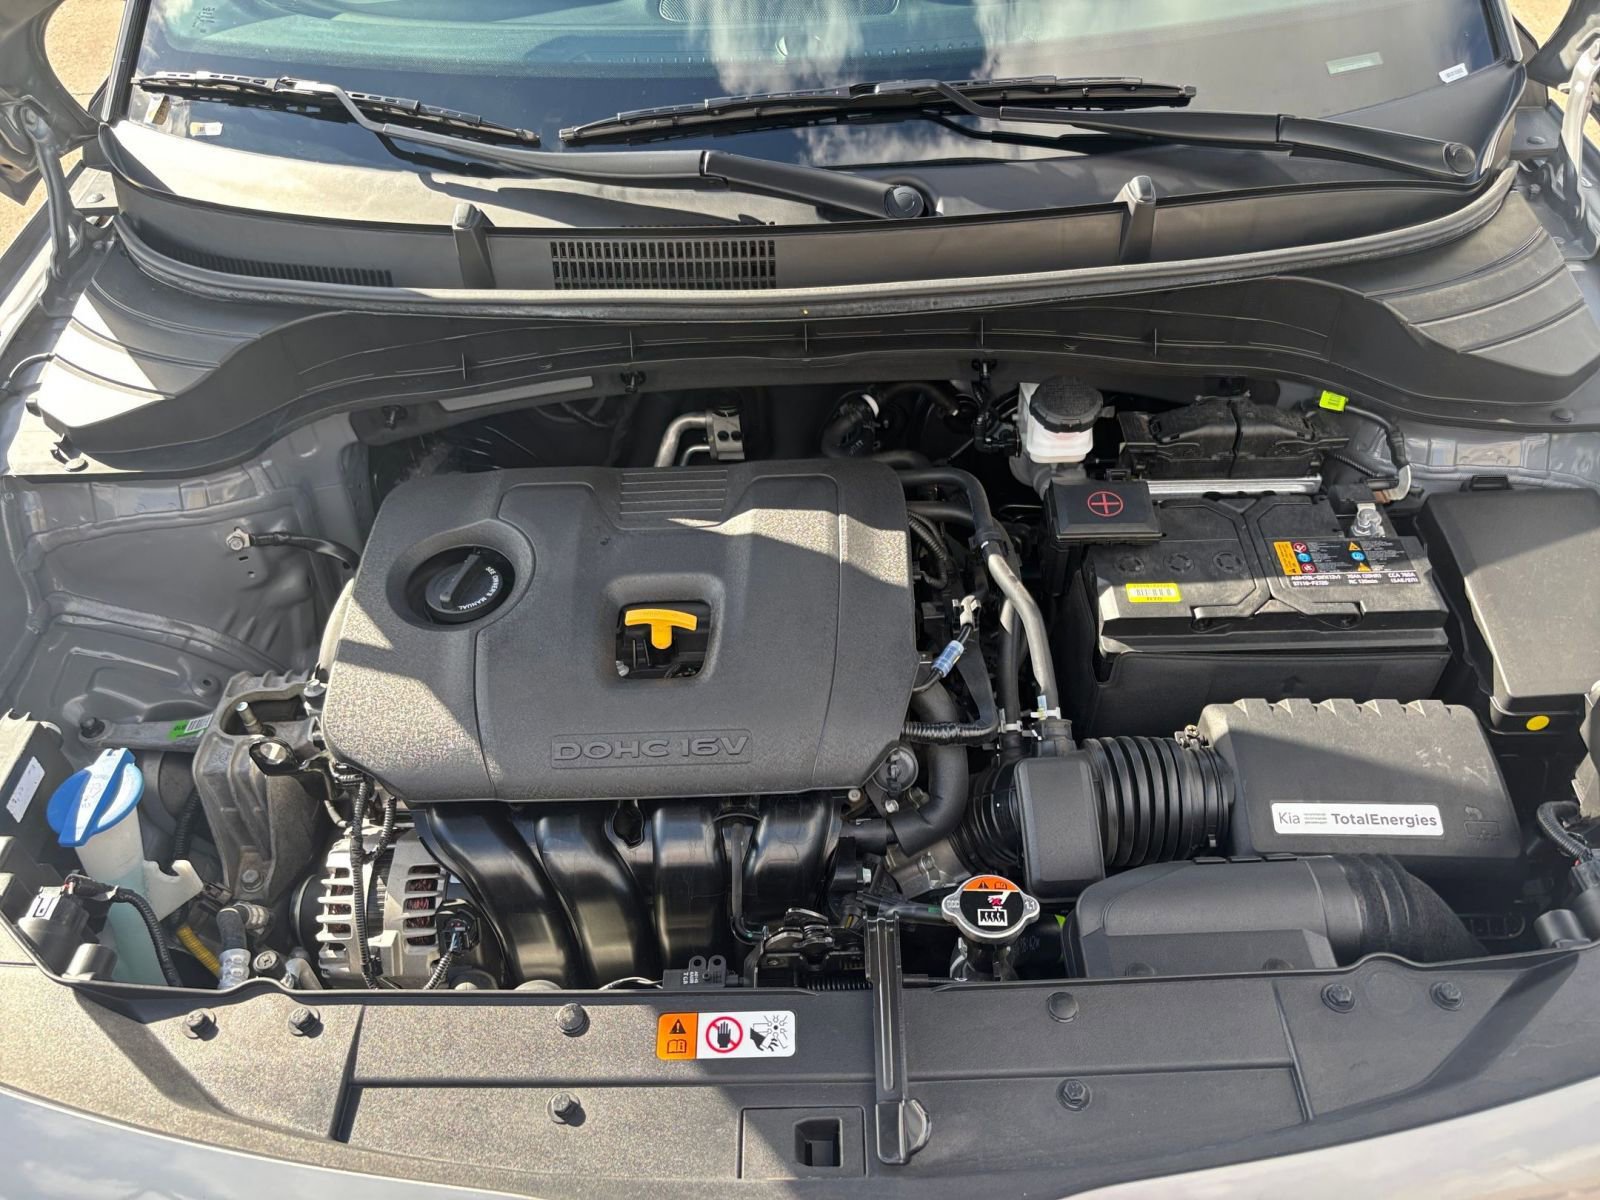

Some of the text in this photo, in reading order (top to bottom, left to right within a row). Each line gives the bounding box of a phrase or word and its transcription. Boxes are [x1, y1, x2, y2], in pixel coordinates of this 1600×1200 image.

[458, 596, 487, 610] MANUAL
[552, 736, 749, 761] DOHC 16V
[1278, 812, 1300, 825] Kia
[1331, 813, 1438, 828] TotalEnergies
[1025, 901, 1036, 910] 1.1
